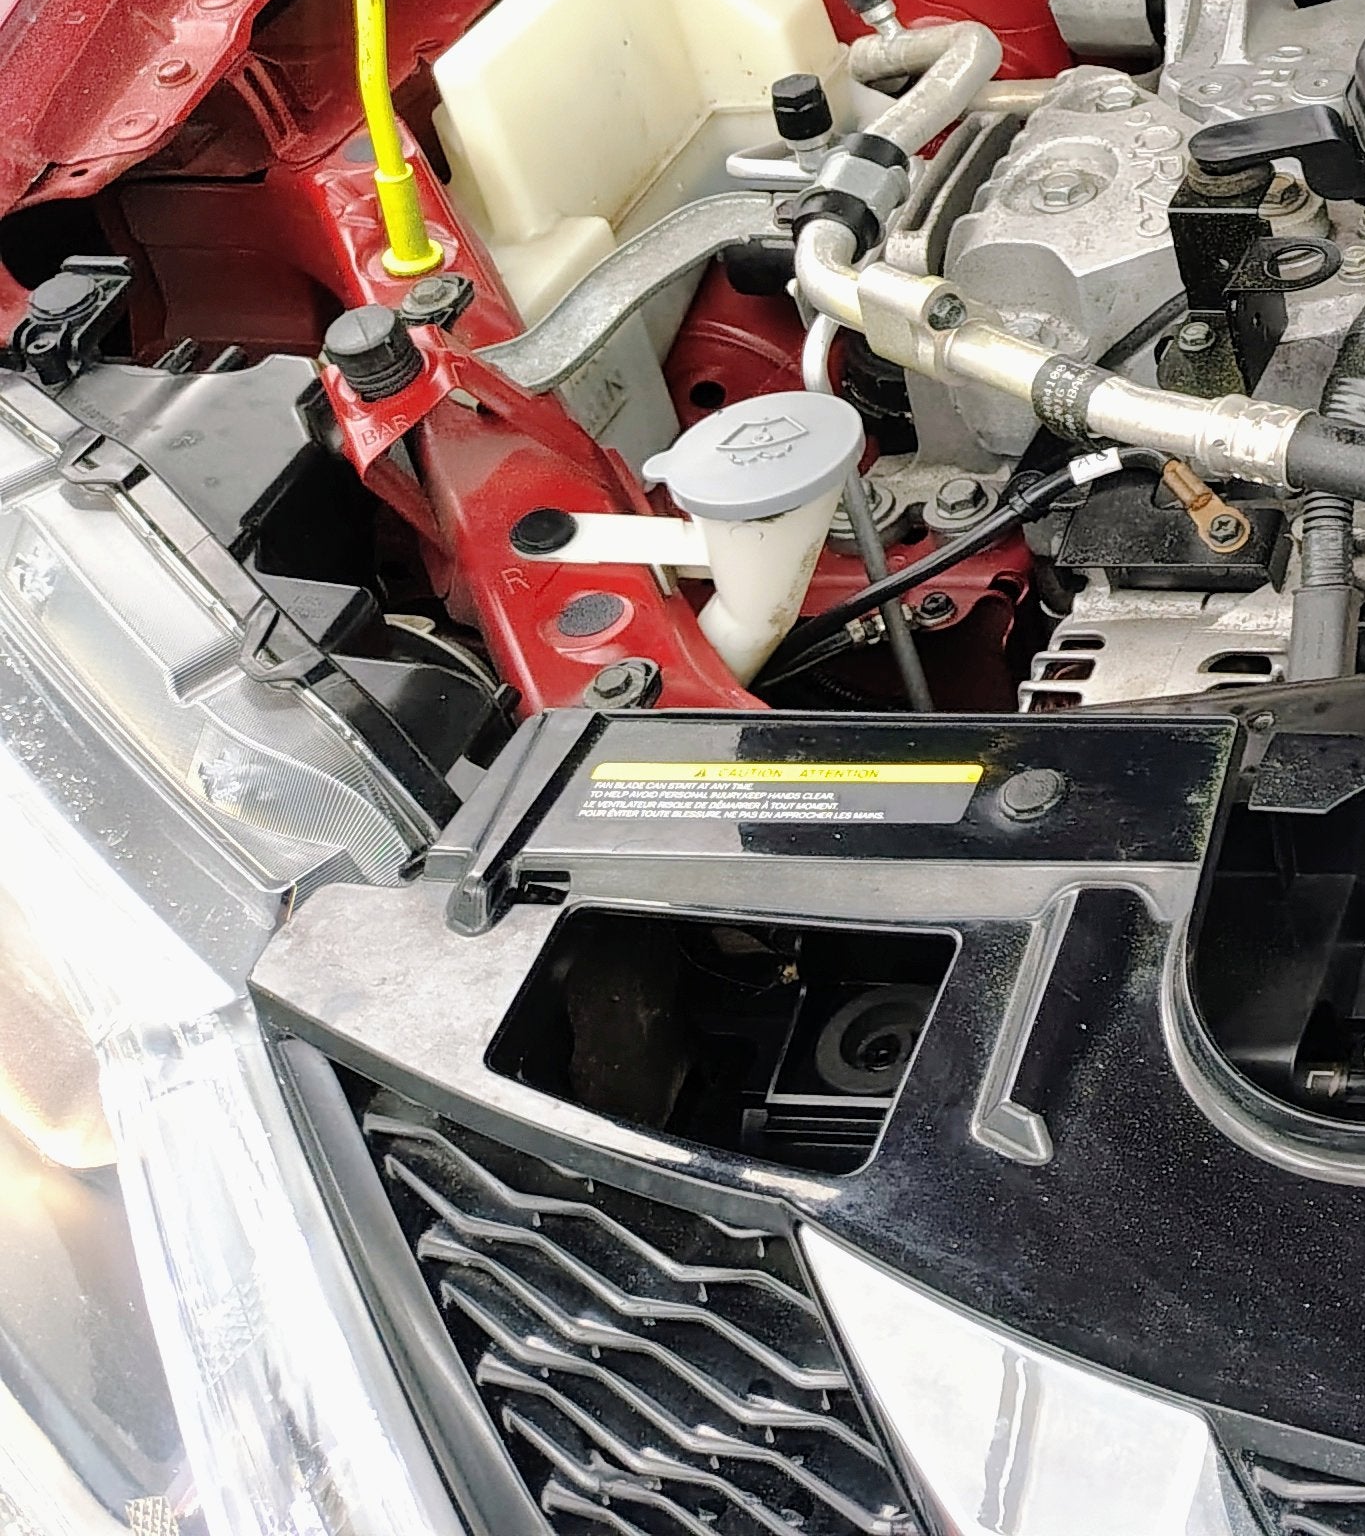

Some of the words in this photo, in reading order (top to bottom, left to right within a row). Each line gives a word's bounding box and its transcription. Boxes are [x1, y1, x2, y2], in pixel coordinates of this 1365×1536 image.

[361, 414, 411, 446] BAR
[501, 567, 531, 595] R
[718, 768, 783, 778] CAUTION
[799, 769, 879, 779] ATTENTION
[593, 781, 613, 790] FAN
[613, 781, 645, 790] BLADE
[645, 782, 668, 790] CAN
[668, 782, 697, 790] START
[697, 782, 710, 790] AT
[710, 782, 731, 790] ANY
[590, 790, 603, 798] TO
[603, 790, 629, 798] HELP
[629, 790, 659, 799] AVOID
[659, 791, 709, 799] PERSONAL
[767, 792, 802, 800] HANDS
[583, 800, 595, 808] LE
[597, 800, 657, 809] VENTILATEUR
[693, 801, 708, 809] DE
[770, 802, 795, 810] TOUT
[578, 810, 605, 818] POUR
[639, 810, 670, 818] TOUTE
[722, 811, 740, 819] NE
[740, 811, 758, 819] PAS
[833, 811, 852, 820] LES
